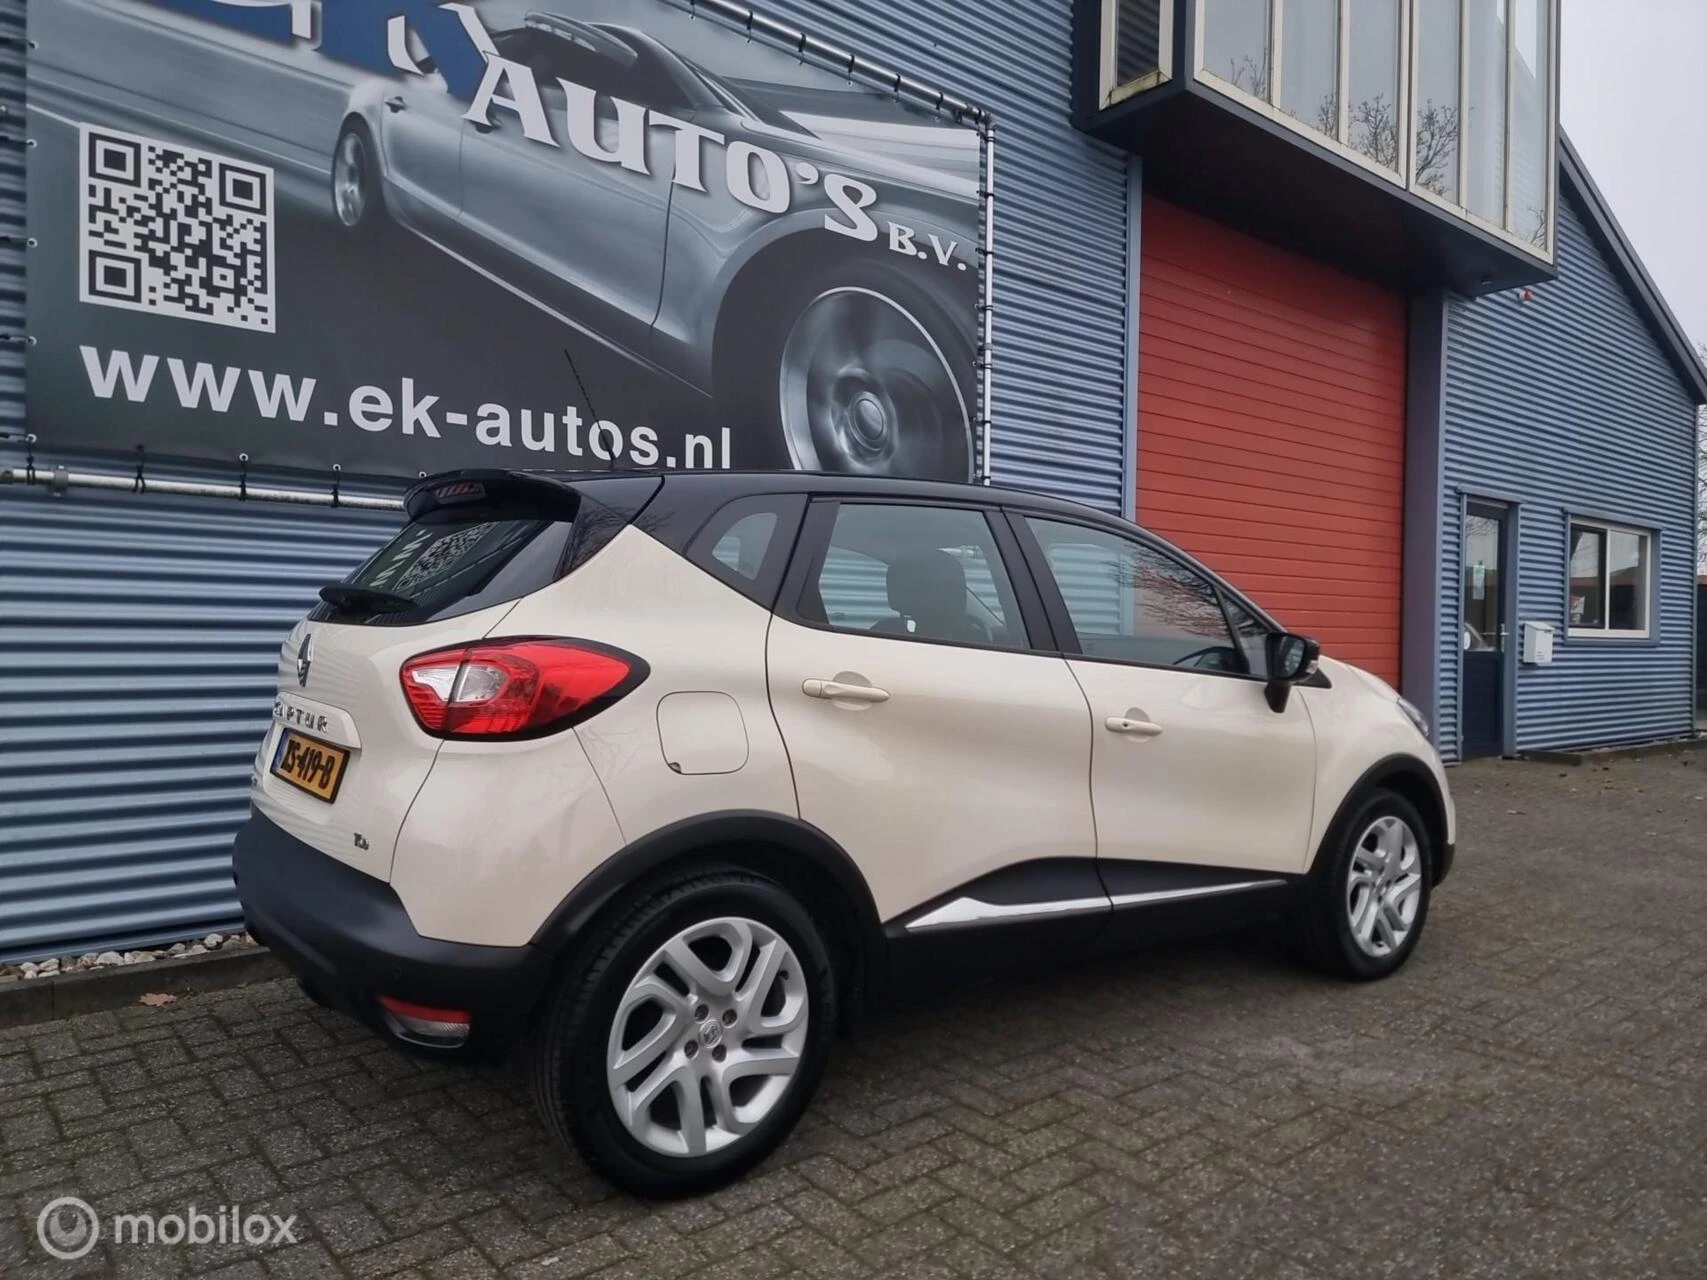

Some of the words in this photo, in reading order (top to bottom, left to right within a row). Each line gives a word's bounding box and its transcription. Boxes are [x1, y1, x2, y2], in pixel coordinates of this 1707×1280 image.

[460, 50, 879, 242] AUTO'S
[887, 220, 968, 271] B.V.
[78, 344, 731, 470] www.ek-autos.nl
[273, 701, 329, 734] CAPTUR
